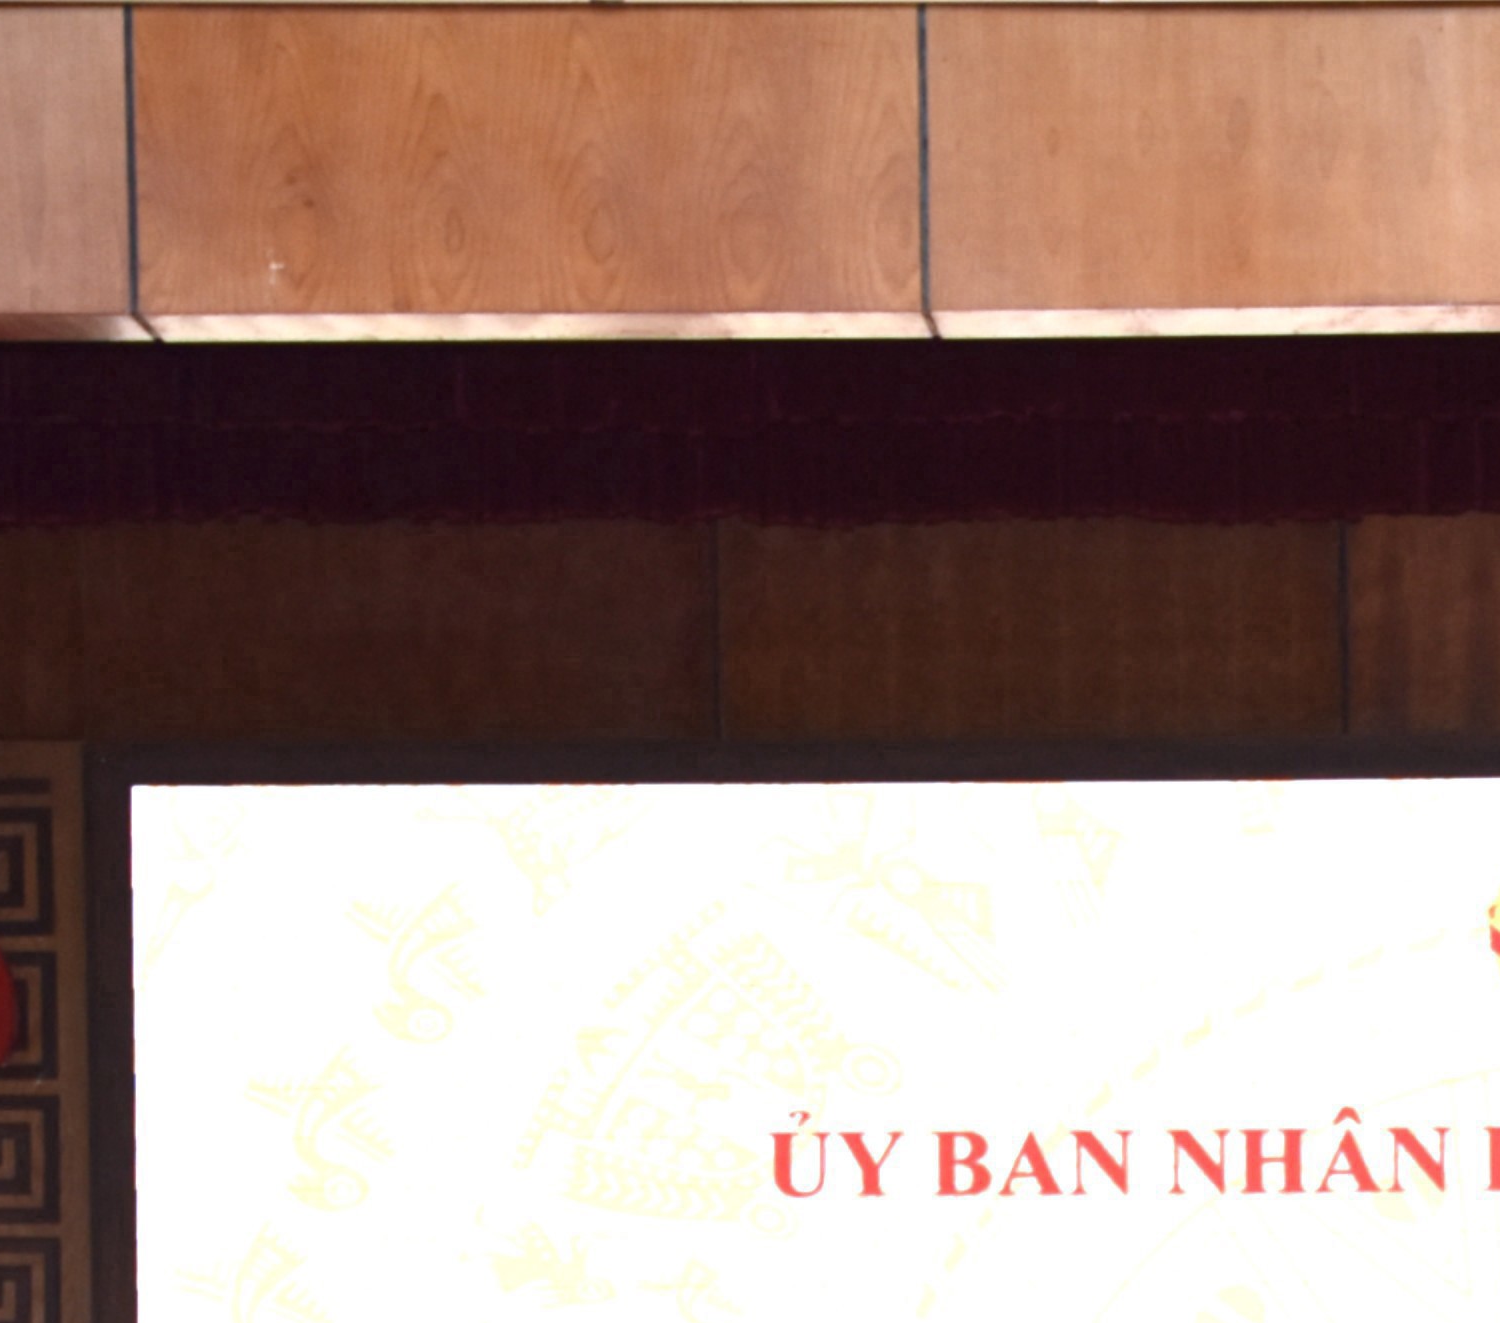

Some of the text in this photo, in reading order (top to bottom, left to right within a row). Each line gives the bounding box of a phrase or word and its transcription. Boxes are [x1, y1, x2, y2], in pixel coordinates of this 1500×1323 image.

[772, 1112, 902, 1198] ỦY
[936, 1130, 1131, 1196] BAN
[1169, 1107, 1449, 1194] NHÂN
